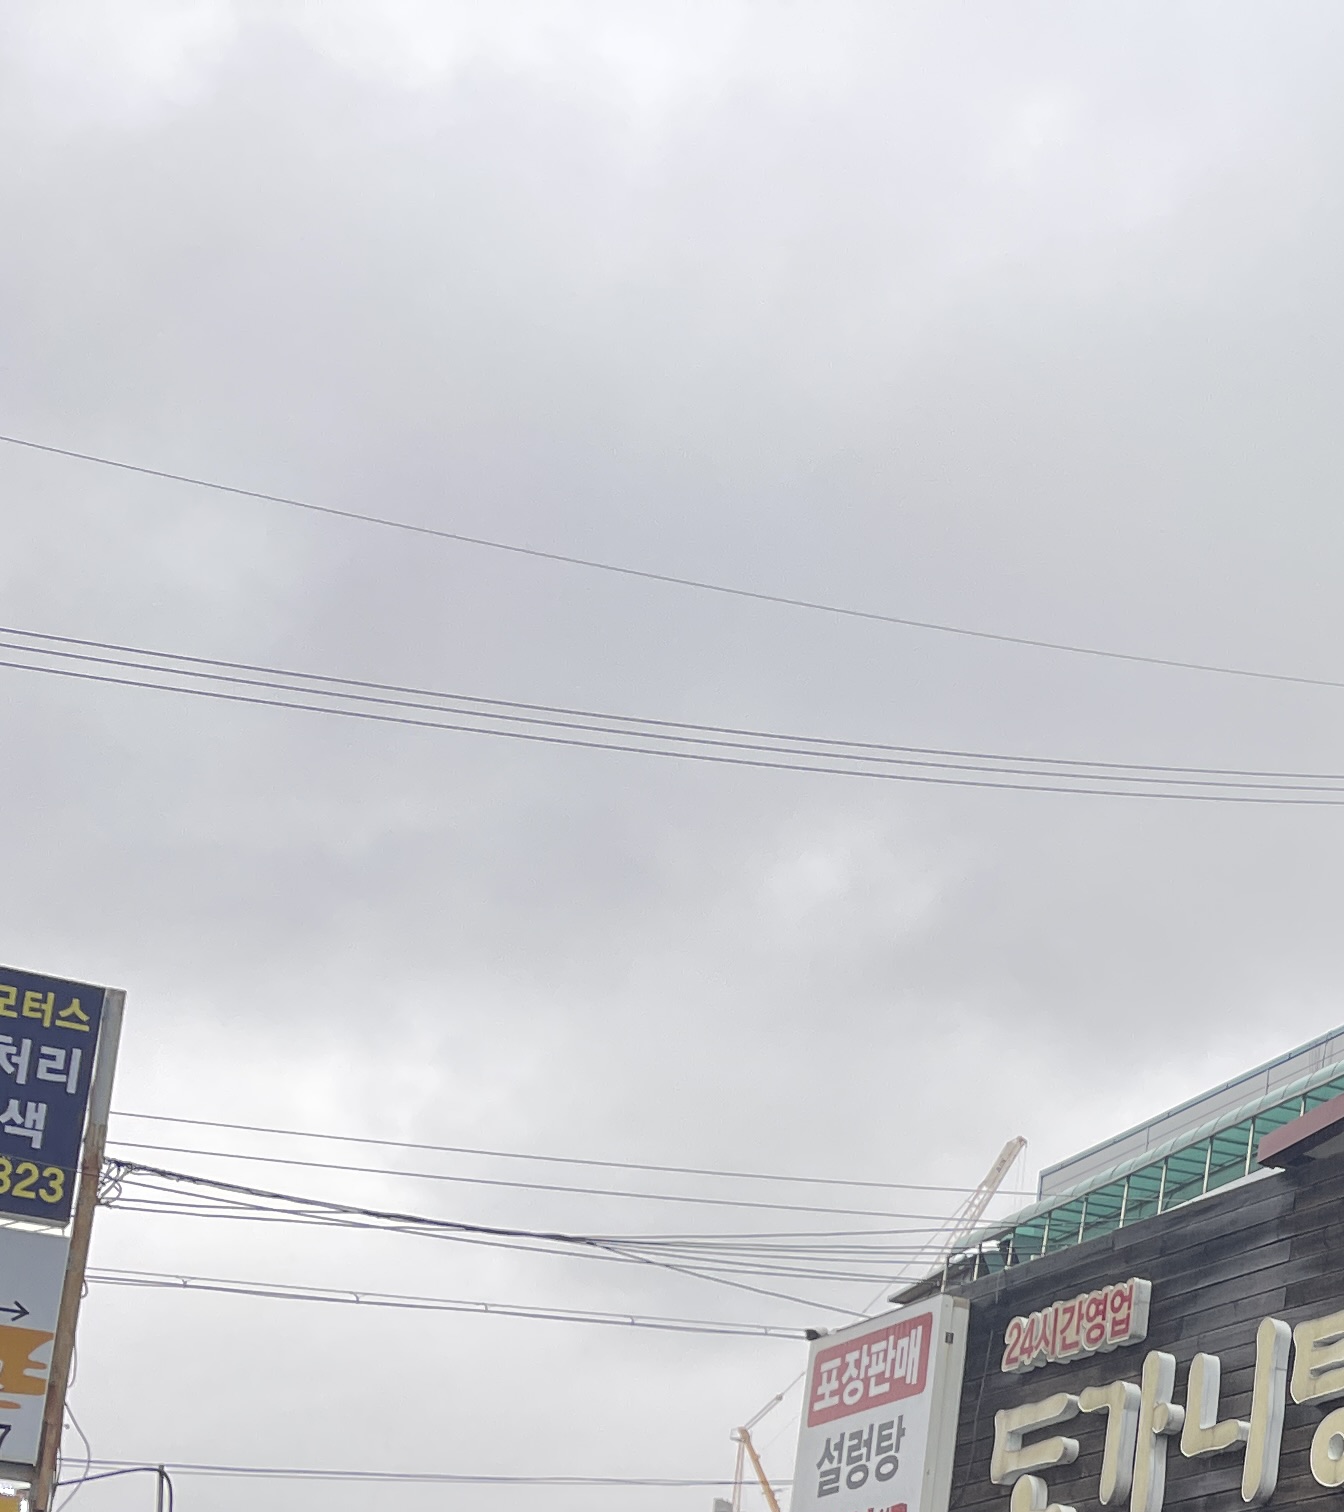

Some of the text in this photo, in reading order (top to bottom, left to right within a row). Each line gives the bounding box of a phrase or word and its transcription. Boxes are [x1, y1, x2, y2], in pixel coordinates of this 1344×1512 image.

[0, 1098, 47, 1150] 색
[1004, 1280, 1134, 1371] 24시간영업
[813, 1325, 923, 1412] 포장판매
[816, 1414, 906, 1498] 설렁탕
